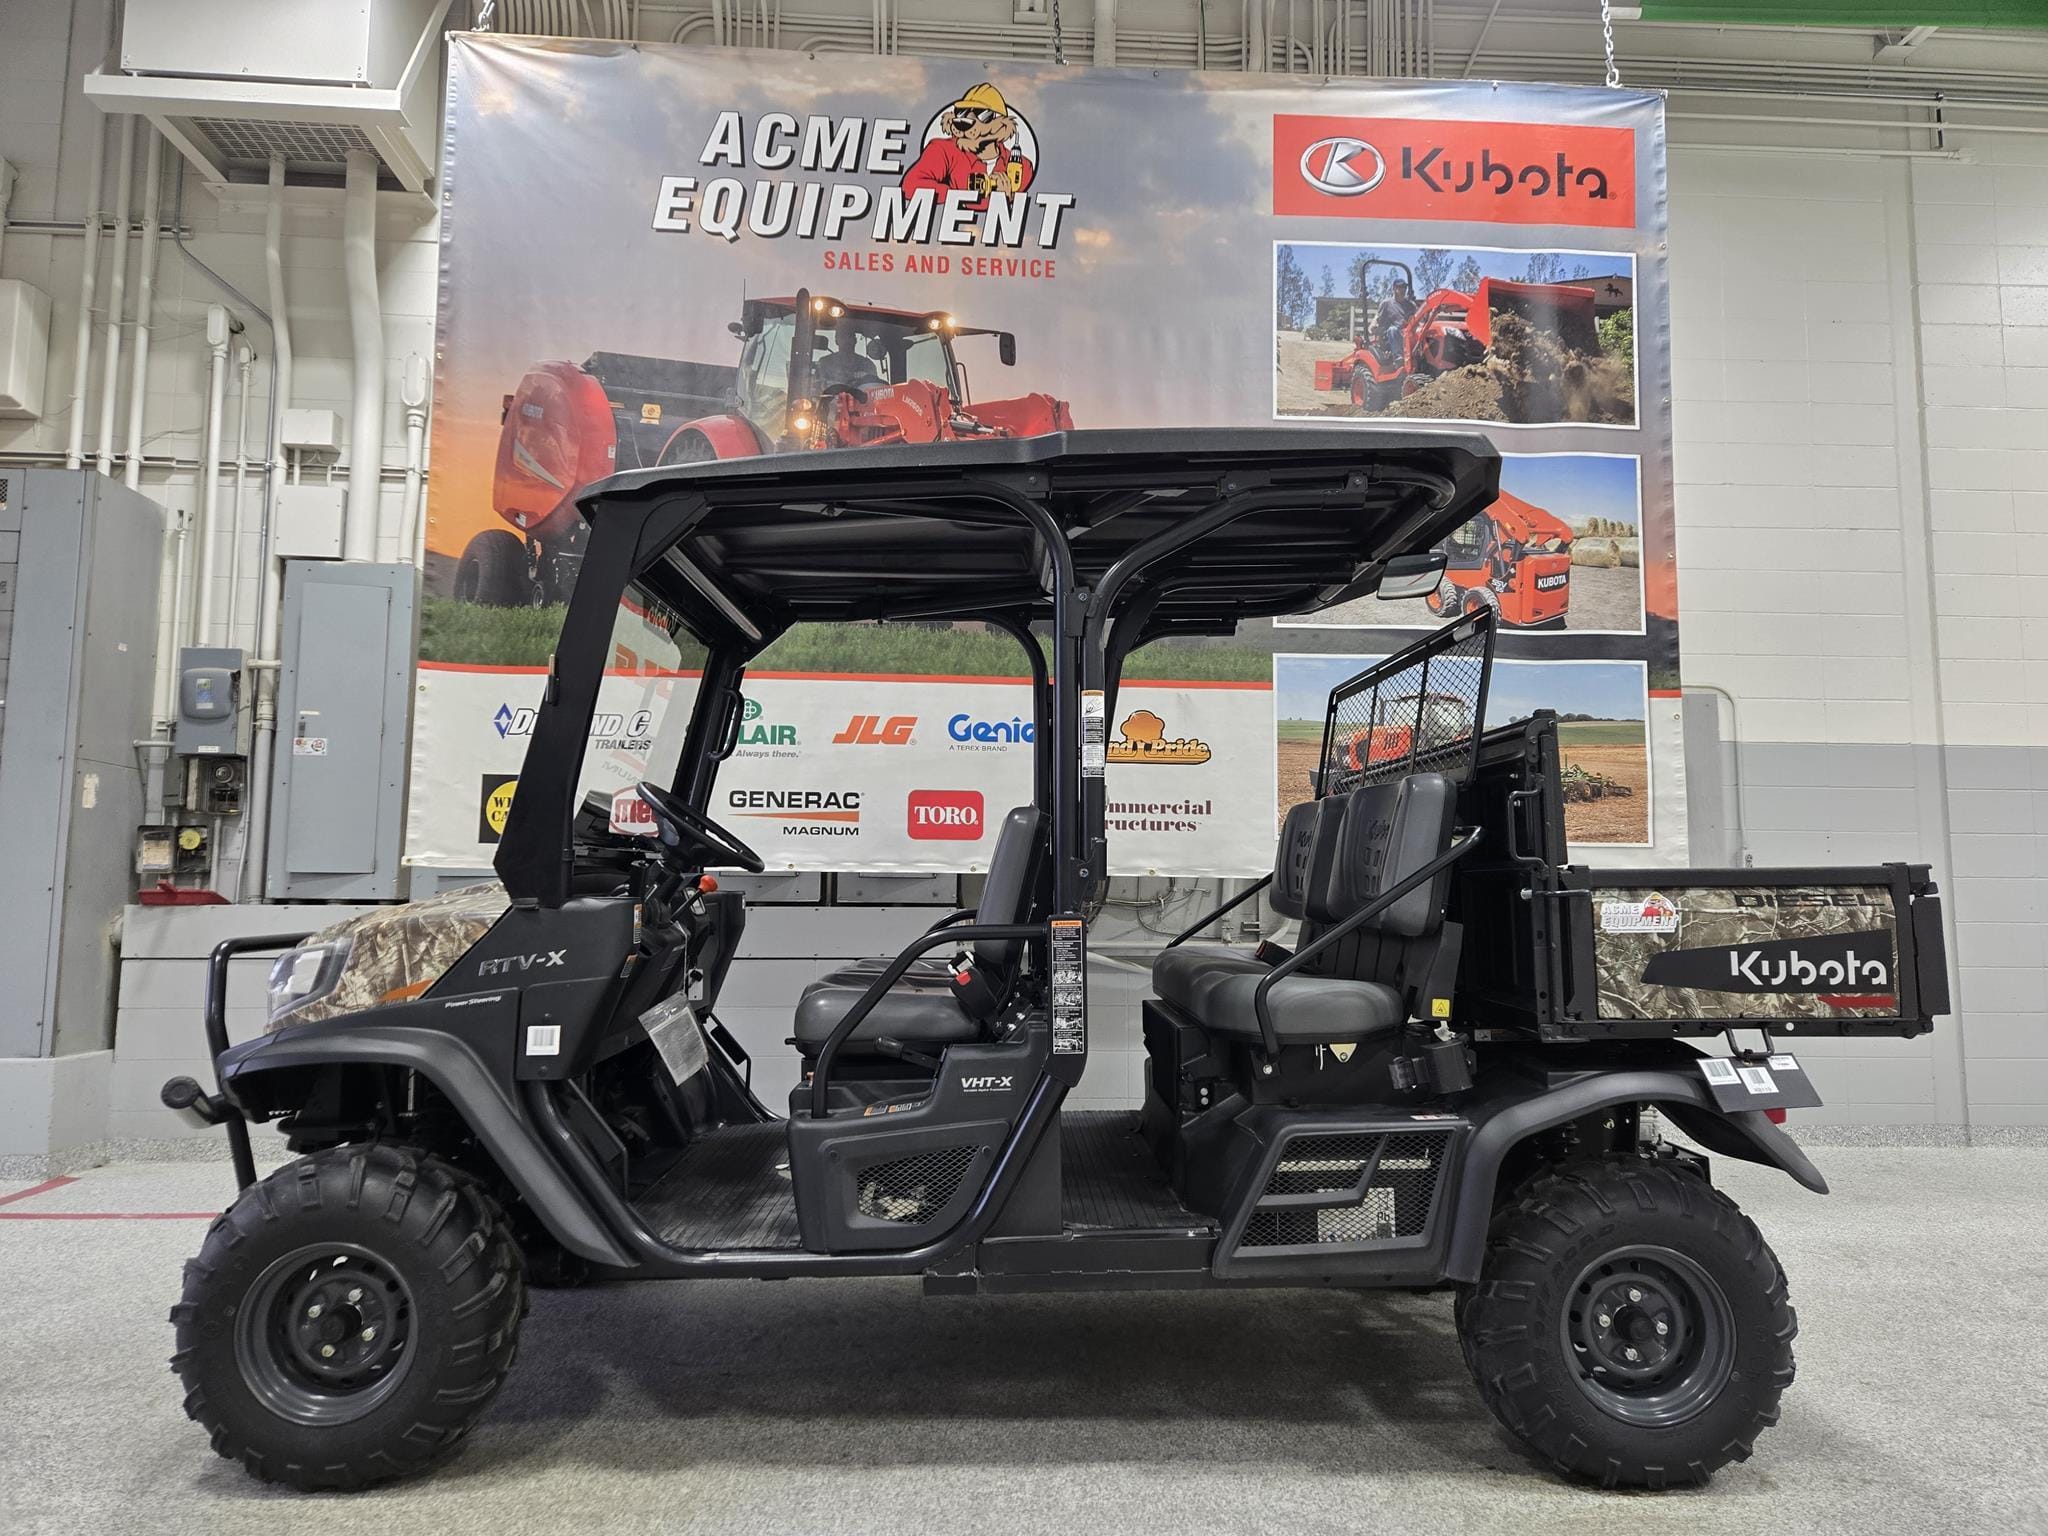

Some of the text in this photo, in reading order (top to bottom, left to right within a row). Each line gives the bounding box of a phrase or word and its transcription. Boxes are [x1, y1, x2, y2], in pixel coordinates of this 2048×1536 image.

[699, 110, 910, 174] ACME
[1402, 146, 1609, 200] Kubota
[651, 174, 1076, 249] EQUIPMENT
[824, 251, 1056, 278] SALES AND SERVICE
[1538, 574, 1567, 589] KUBOTA
[627, 709, 652, 737] C
[832, 715, 918, 744] JLG
[595, 739, 651, 750] TRAILERS
[738, 725, 796, 745] LAIR
[736, 750, 769, 758] Always
[1148, 738, 1209, 756] Pride
[729, 790, 860, 809] GENERAC
[1105, 799, 1211, 815] mmercial
[914, 805, 977, 825] TORO
[783, 826, 859, 836] MAGNUM
[1105, 818, 1197, 832] ructures
[1602, 905, 1639, 915] ACME
[1602, 914, 1679, 928] EQUIPMENT
[478, 949, 567, 976] RTV-X
[1730, 950, 1888, 986] Kubota
[961, 1076, 1013, 1088] VHT-X
